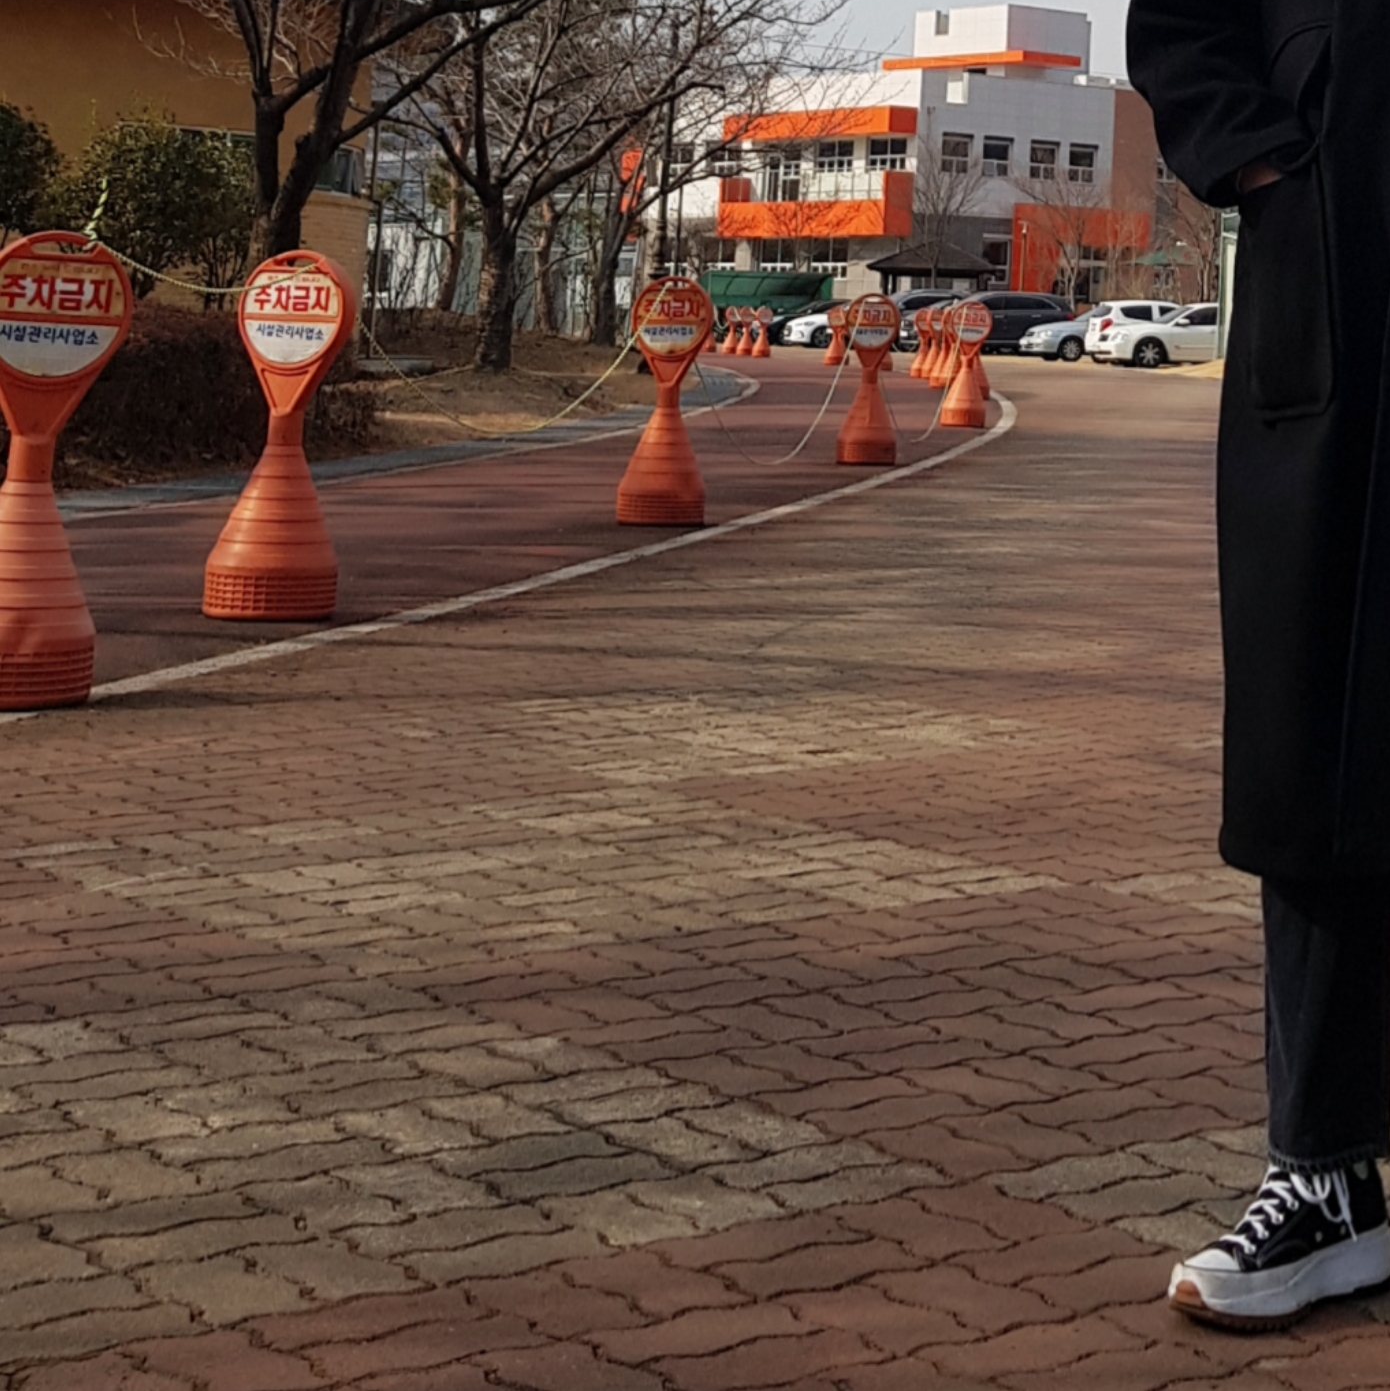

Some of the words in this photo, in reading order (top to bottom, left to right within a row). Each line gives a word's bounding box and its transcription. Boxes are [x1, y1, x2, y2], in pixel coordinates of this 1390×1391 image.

[0, 274, 115, 314] 주차금지
[253, 284, 331, 313] 주차금지
[0, 324, 100, 346] 시설관리사업소
[255, 323, 324, 341] 시설관리사업소
